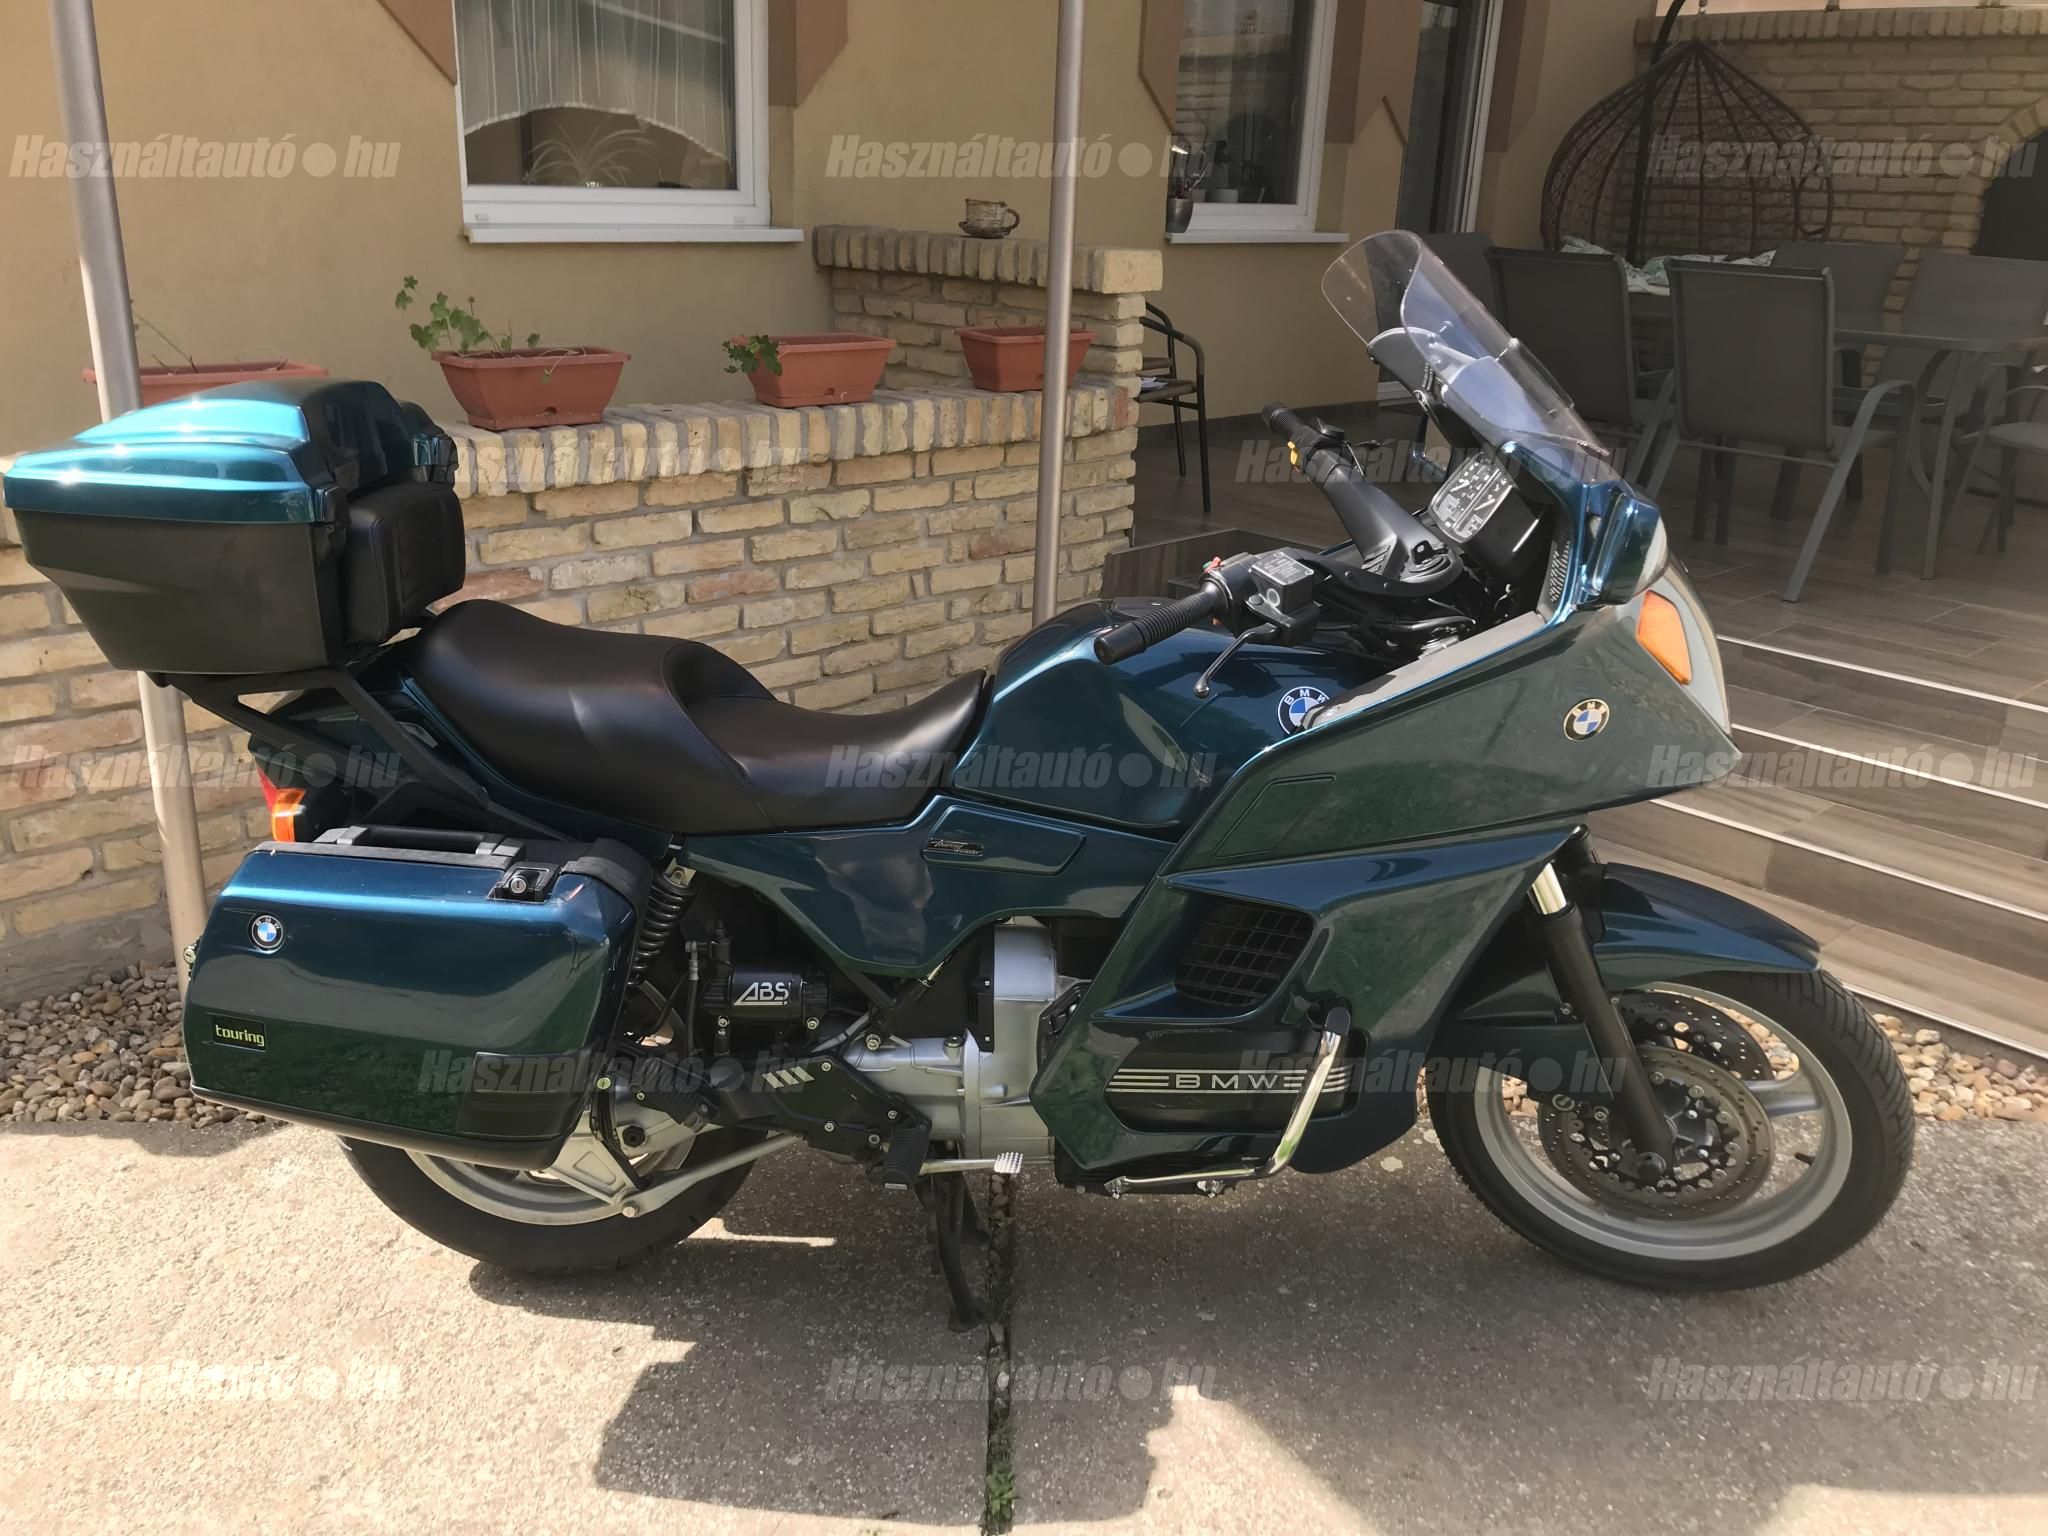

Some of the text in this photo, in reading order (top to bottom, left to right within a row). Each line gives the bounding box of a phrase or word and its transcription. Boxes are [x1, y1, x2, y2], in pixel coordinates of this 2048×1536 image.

[733, 981, 789, 1006] ABS
[215, 1024, 265, 1047] touring
[1175, 1074, 1279, 1089] BMW
